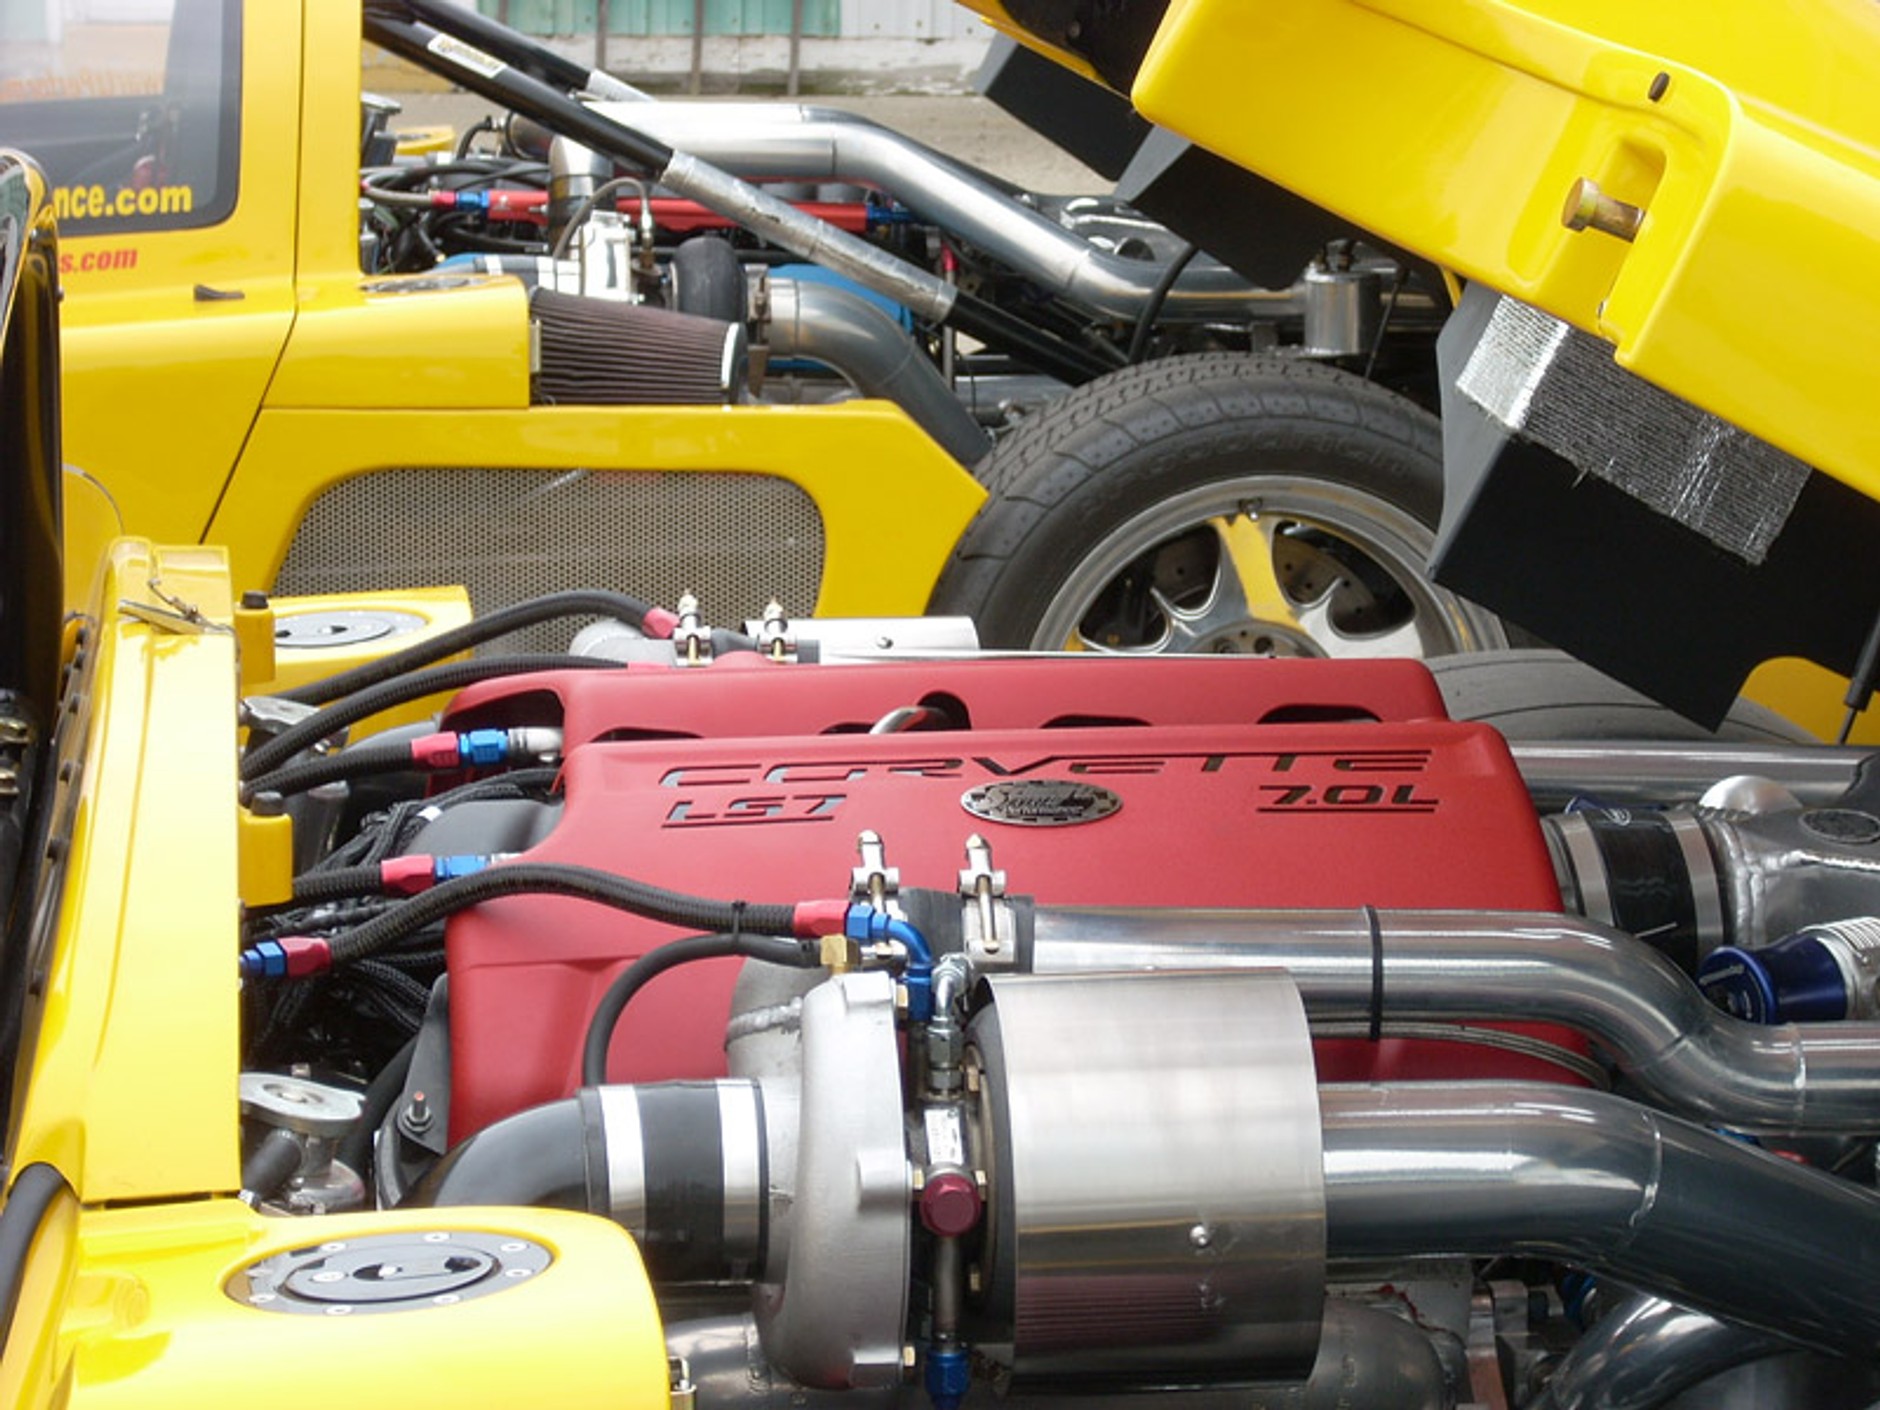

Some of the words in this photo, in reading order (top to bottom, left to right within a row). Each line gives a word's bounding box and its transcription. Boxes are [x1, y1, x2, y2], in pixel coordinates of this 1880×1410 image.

[53, 184, 192, 219] nce.com
[59, 250, 137, 273] s.com
[659, 750, 1432, 787] CORVETTE
[665, 794, 847, 822] LS7
[1259, 785, 1440, 806] 7.0L
